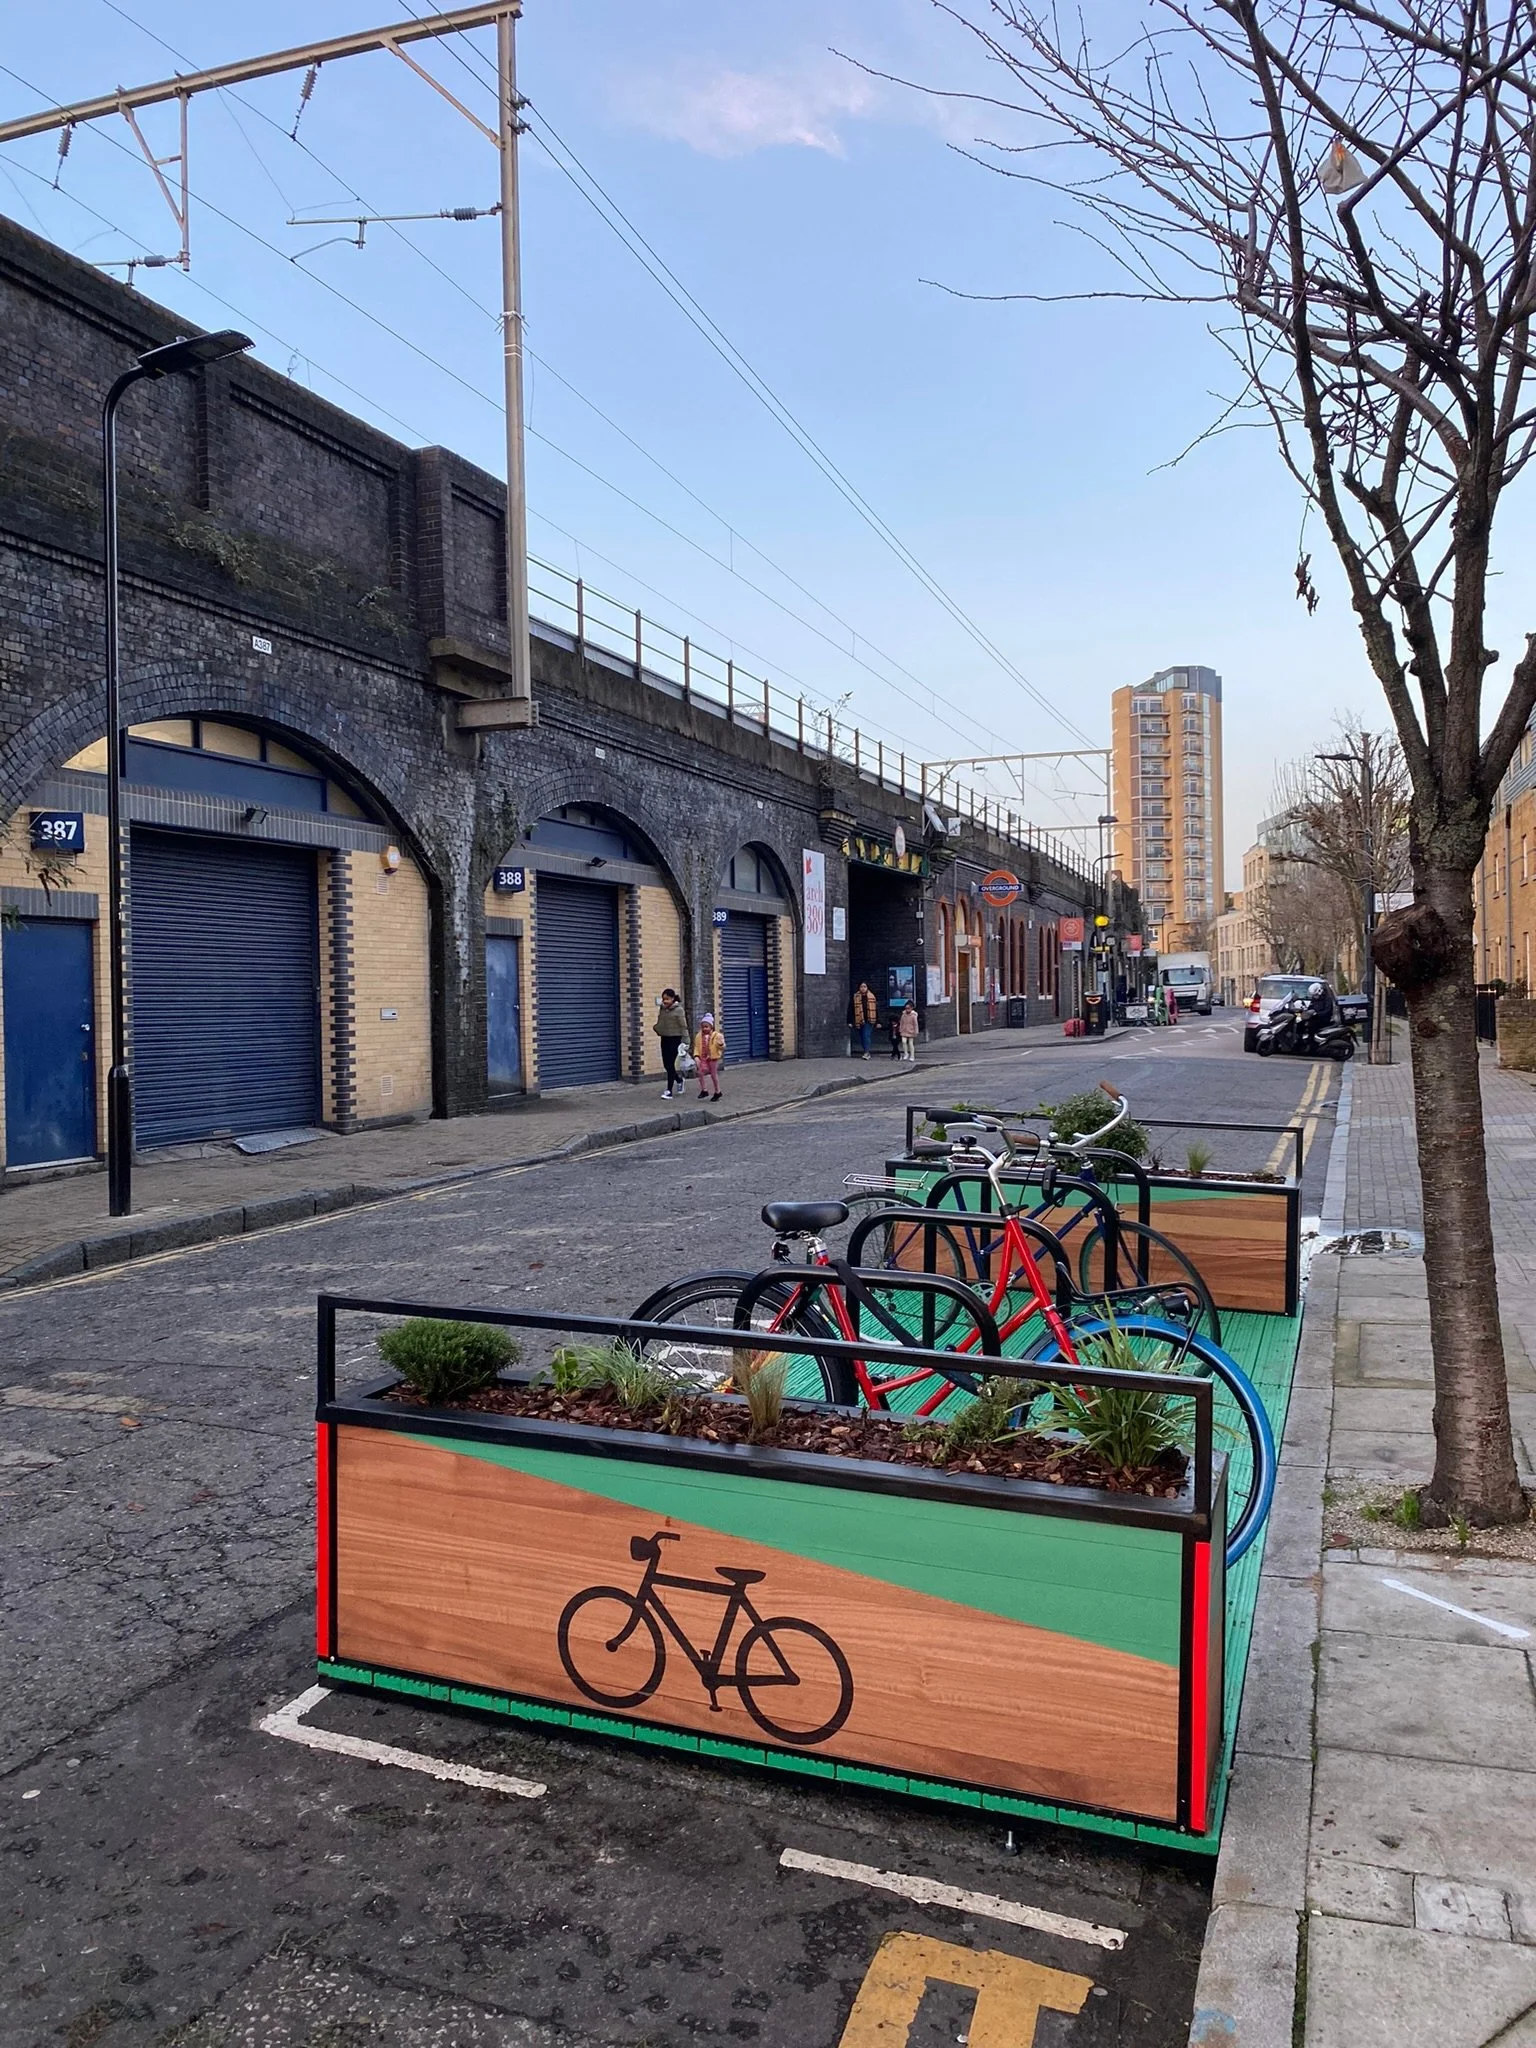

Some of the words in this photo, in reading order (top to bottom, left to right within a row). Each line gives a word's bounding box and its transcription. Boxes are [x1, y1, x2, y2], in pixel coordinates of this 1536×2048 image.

[254, 638, 270, 651] A387
[41, 820, 77, 841] 387
[499, 871, 522, 885] 388
[806, 881, 823, 902] arch
[712, 911, 727, 922] 389
[807, 904, 823, 935] 389
